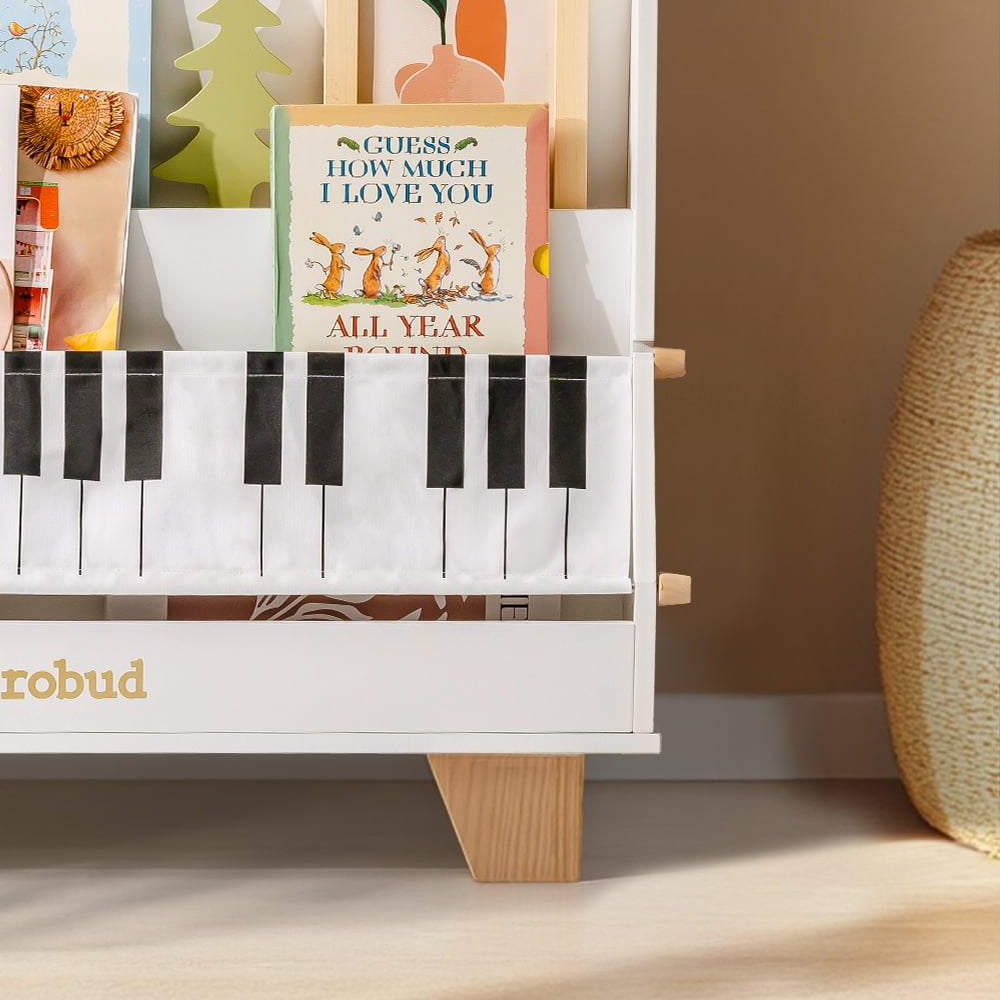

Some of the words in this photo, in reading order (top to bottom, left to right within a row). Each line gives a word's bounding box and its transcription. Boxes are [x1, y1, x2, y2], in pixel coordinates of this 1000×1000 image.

[363, 136, 451, 155] GUESS
[327, 159, 393, 178] HOW
[402, 159, 488, 178] MUCH
[320, 182, 330, 204] I
[342, 183, 422, 205] LOVE
[429, 183, 494, 204] YOU
[326, 314, 388, 339] ALL
[397, 314, 485, 339] YEAR
[0, 658, 148, 700] robud
